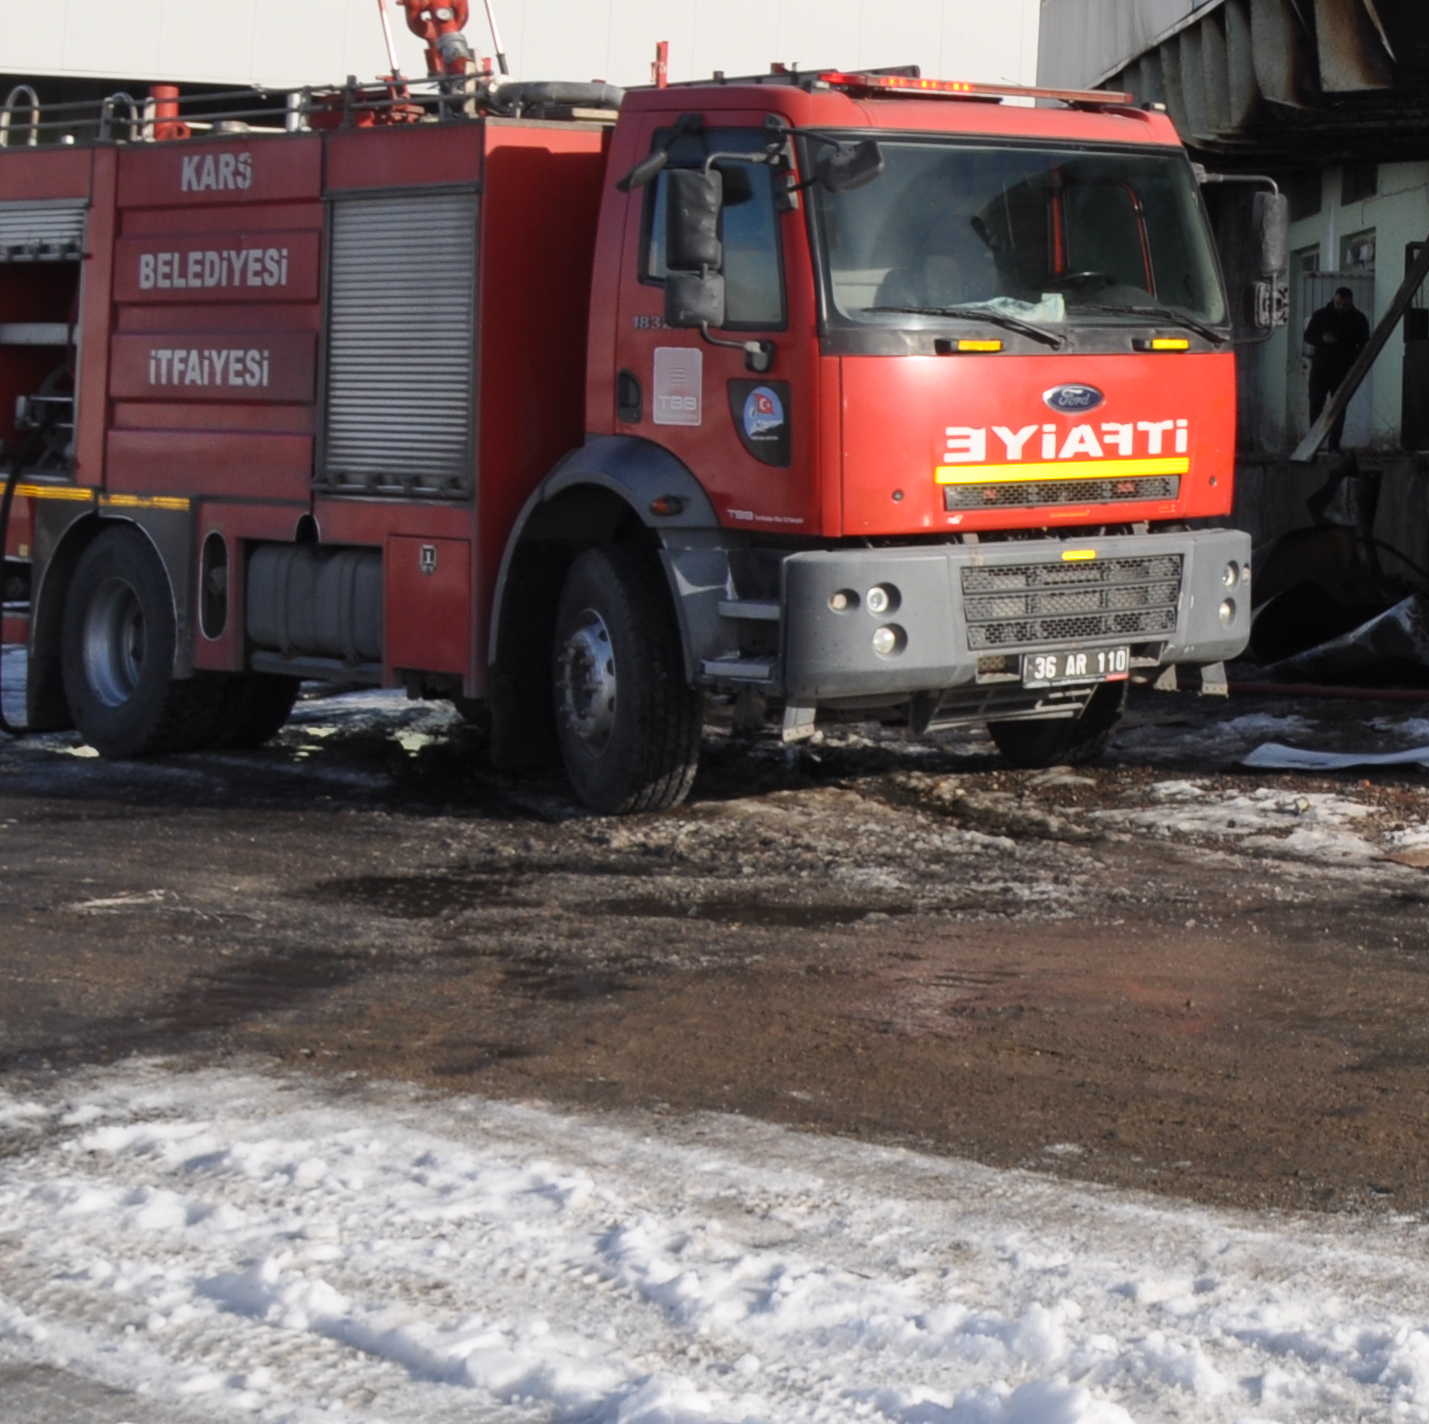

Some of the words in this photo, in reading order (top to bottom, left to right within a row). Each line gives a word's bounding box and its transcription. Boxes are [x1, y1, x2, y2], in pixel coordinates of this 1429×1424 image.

[181, 152, 253, 192] KARS
[1057, 388, 1091, 407] Ford
[1034, 656, 1057, 679] 36
[1065, 653, 1087, 676] AR
[1097, 650, 1126, 673] 110
